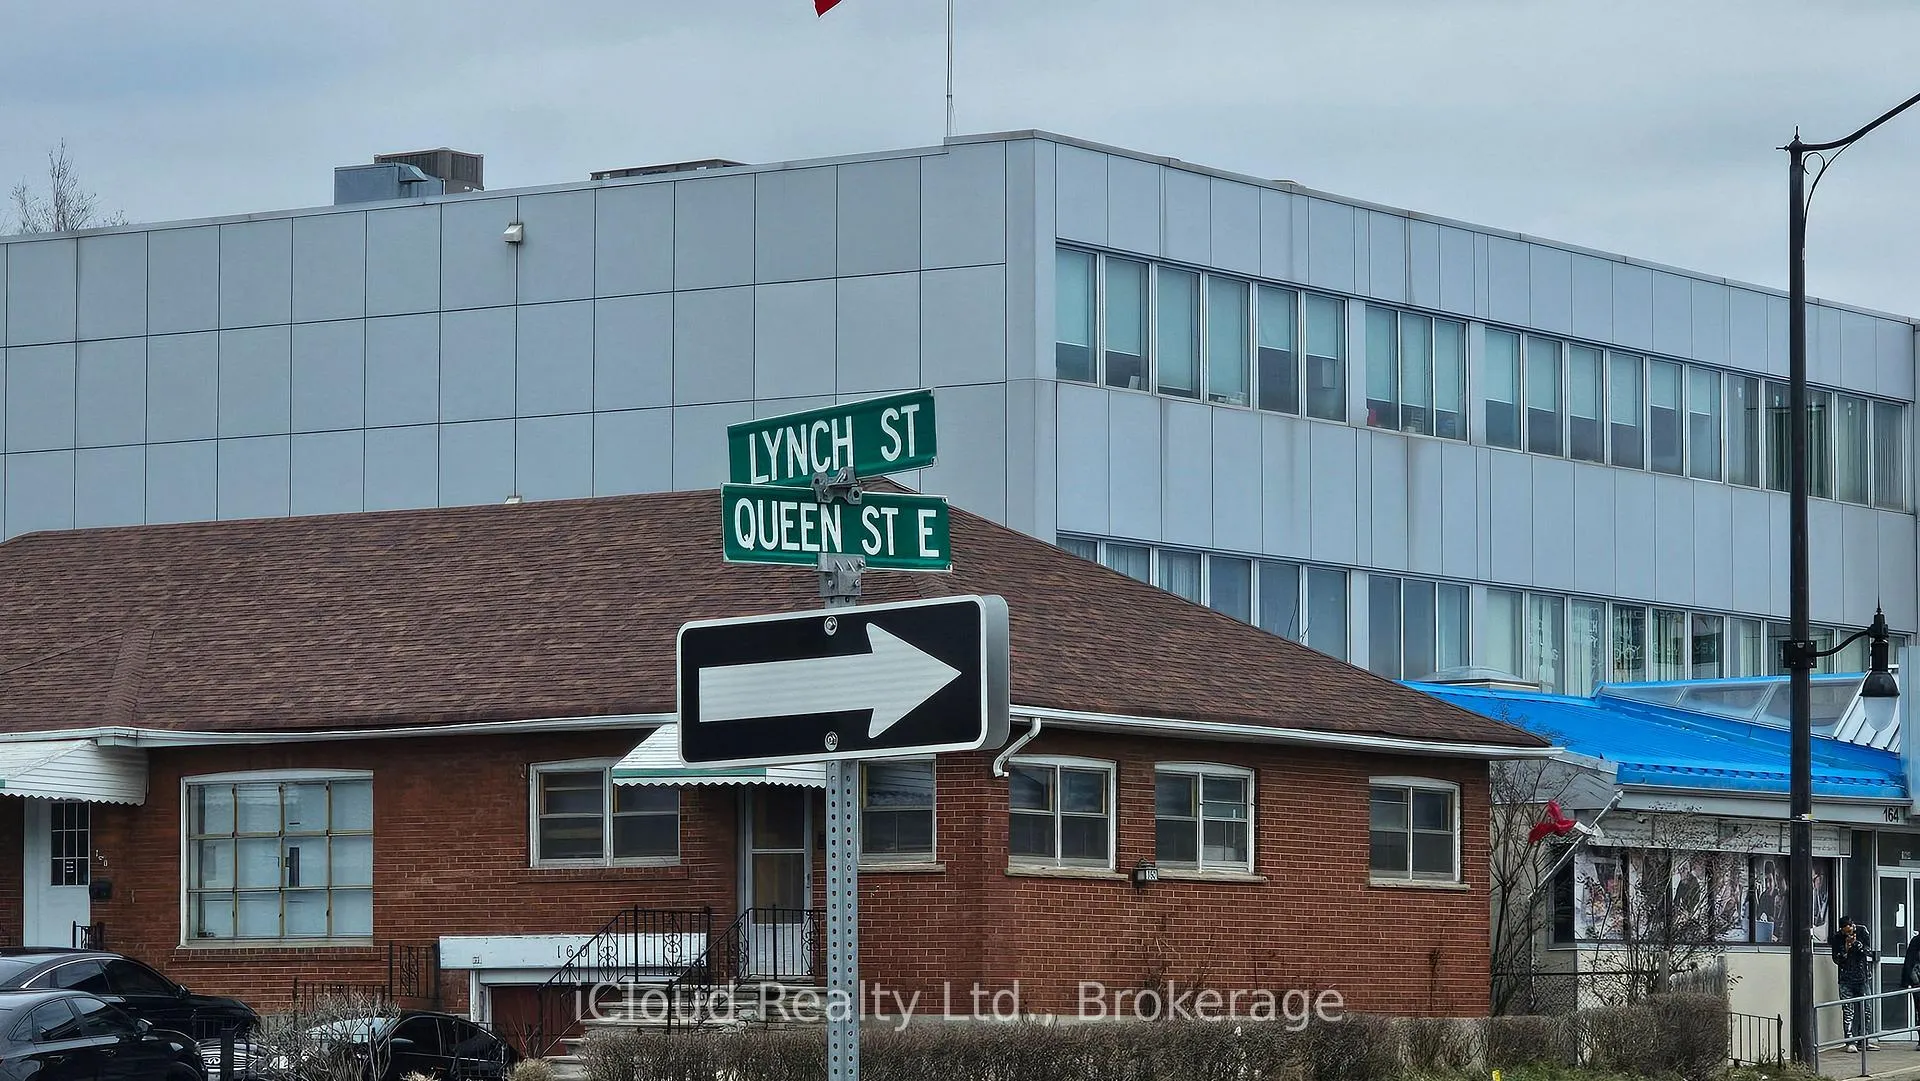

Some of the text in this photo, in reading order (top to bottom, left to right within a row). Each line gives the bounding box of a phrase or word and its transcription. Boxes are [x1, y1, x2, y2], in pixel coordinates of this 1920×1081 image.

[749, 404, 920, 484] LYNCH ST
[734, 497, 940, 558] QUEEN ST E
[1883, 805, 1899, 823] 164
